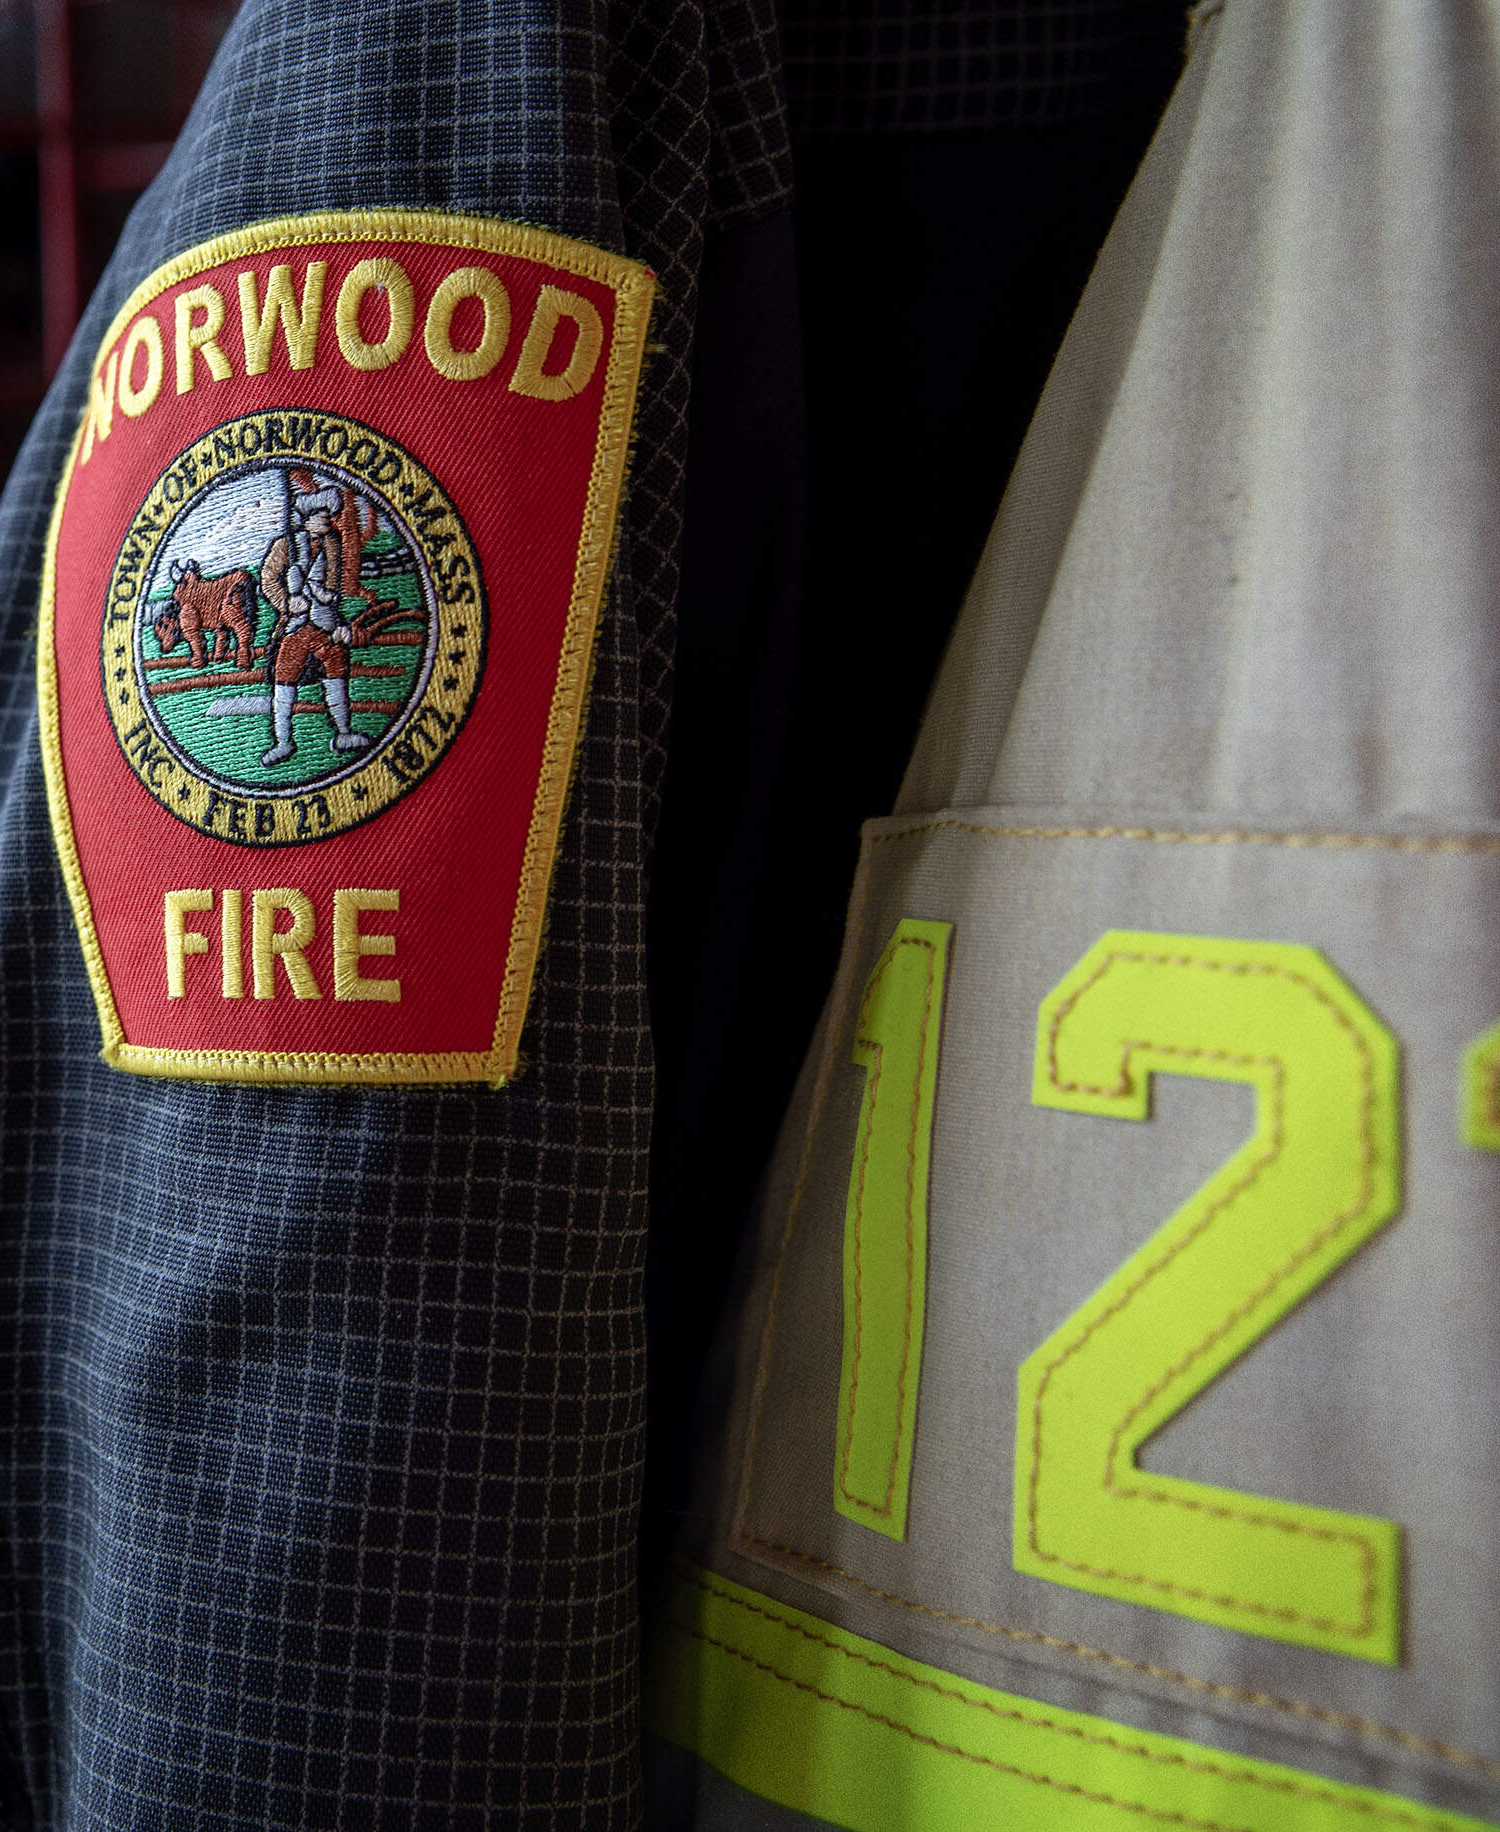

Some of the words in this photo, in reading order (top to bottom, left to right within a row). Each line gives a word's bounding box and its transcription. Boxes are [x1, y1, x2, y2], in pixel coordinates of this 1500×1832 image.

[80, 257, 605, 467] NORWOOD
[108, 514, 161, 630] TOWN
[163, 464, 202, 504] OF
[213, 417, 403, 486] NORWOOD
[407, 495, 477, 606] MASS
[122, 721, 177, 790] INC
[202, 791, 276, 840] FEB
[382, 705, 456, 784] 1872
[164, 887, 402, 1003] FIRE
[832, 917, 1500, 1666] 12
